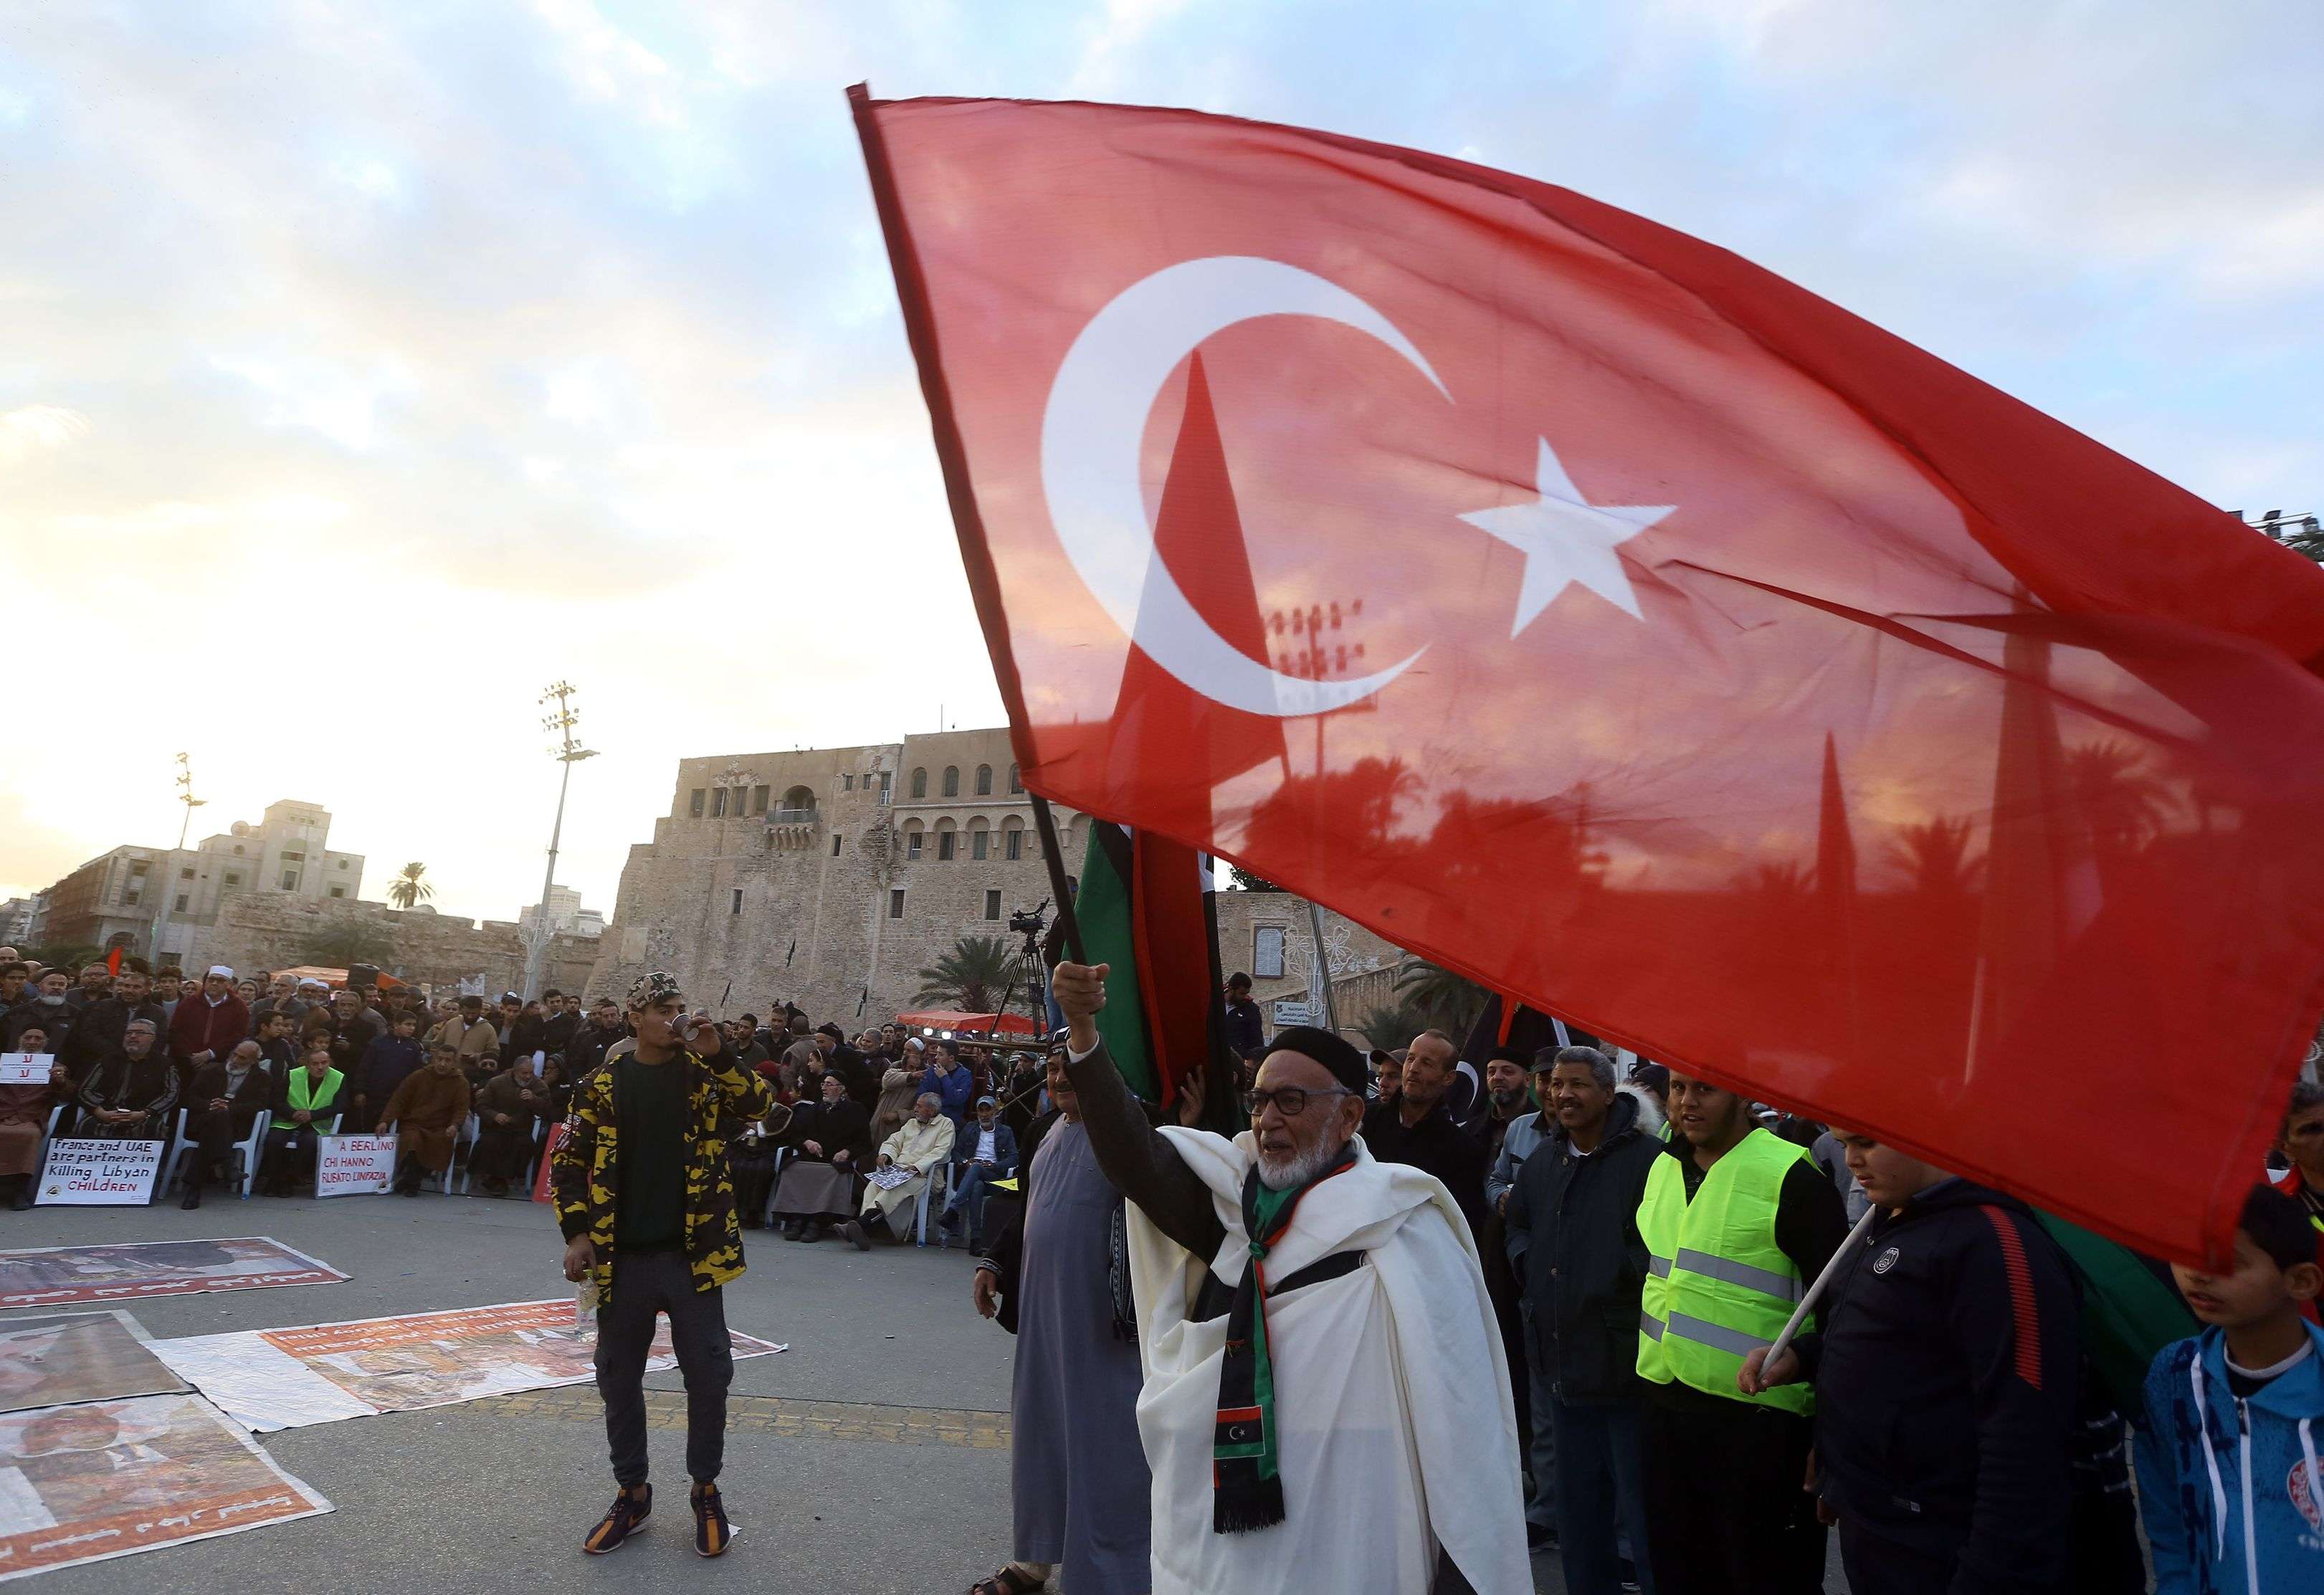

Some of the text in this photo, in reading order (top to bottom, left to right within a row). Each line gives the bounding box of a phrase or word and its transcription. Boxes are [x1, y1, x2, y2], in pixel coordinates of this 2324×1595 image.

[54, 1138, 153, 1152] France and UAE
[339, 1141, 395, 1151] A BERLINO
[50, 1152, 73, 1161] are
[141, 1153, 154, 1163] in
[340, 1157, 374, 1167] HANNO
[49, 1164, 150, 1180] Killing Libyan
[321, 1172, 352, 1183] RUBATO
